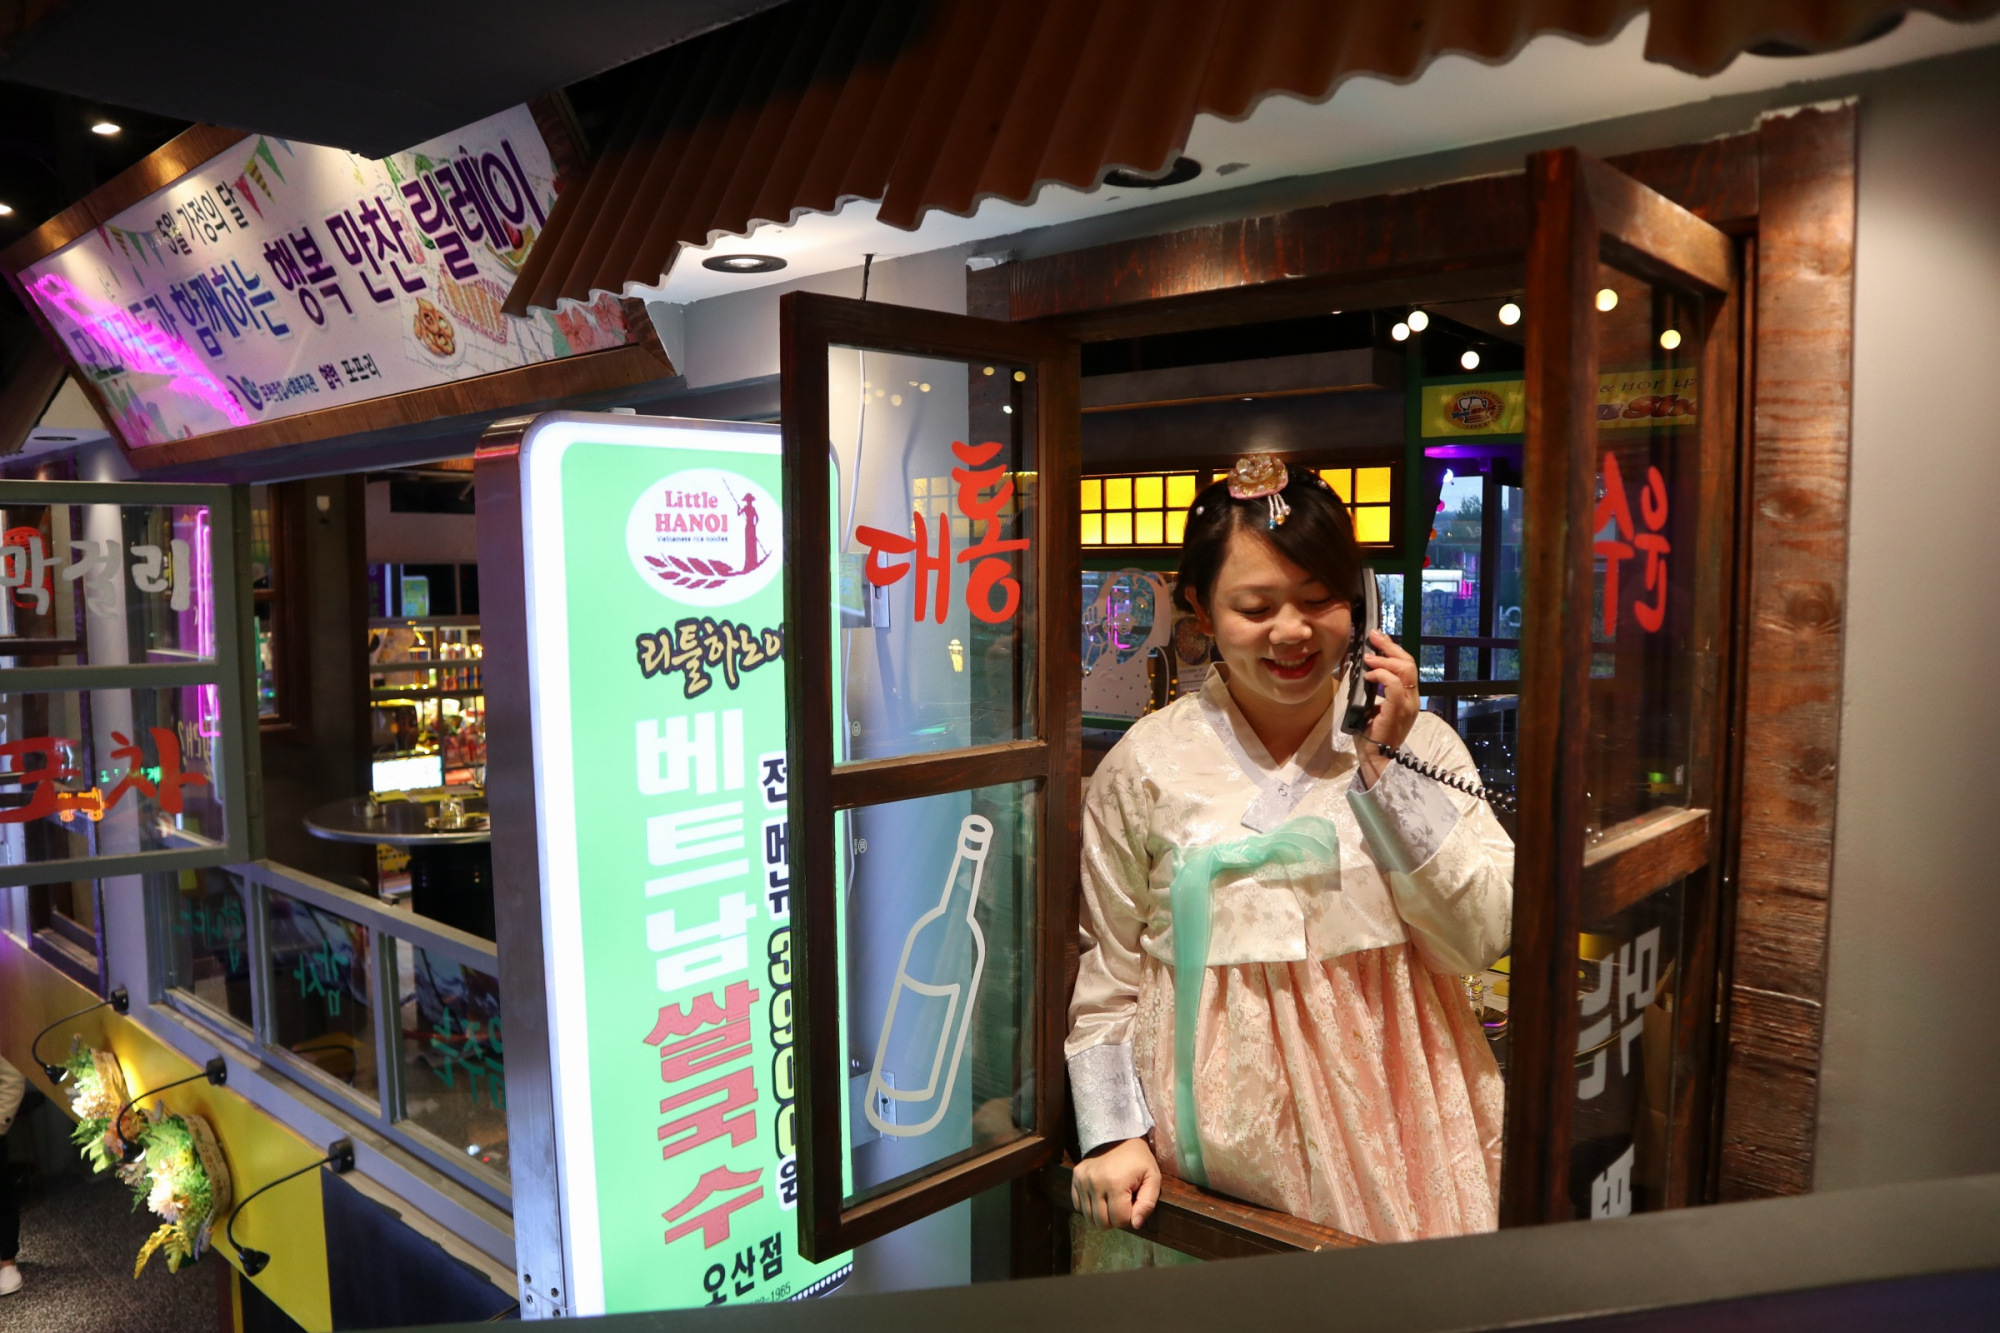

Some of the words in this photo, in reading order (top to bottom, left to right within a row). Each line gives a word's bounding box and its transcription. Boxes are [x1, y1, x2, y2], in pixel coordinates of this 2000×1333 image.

[155, 211, 193, 256] 5월
[176, 190, 232, 246] 가정의
[215, 180, 250, 230] 달
[169, 259, 291, 358] 함께하는
[262, 226, 354, 326] 행복
[325, 195, 428, 304] 만찬
[400, 138, 547, 281] 릴레이
[341, 353, 382, 383] 포프리
[654, 513, 729, 533] HANOI
[664, 490, 719, 509] Little
[0, 536, 191, 620] 막걸리
[703, 1231, 783, 1308] 오산점
